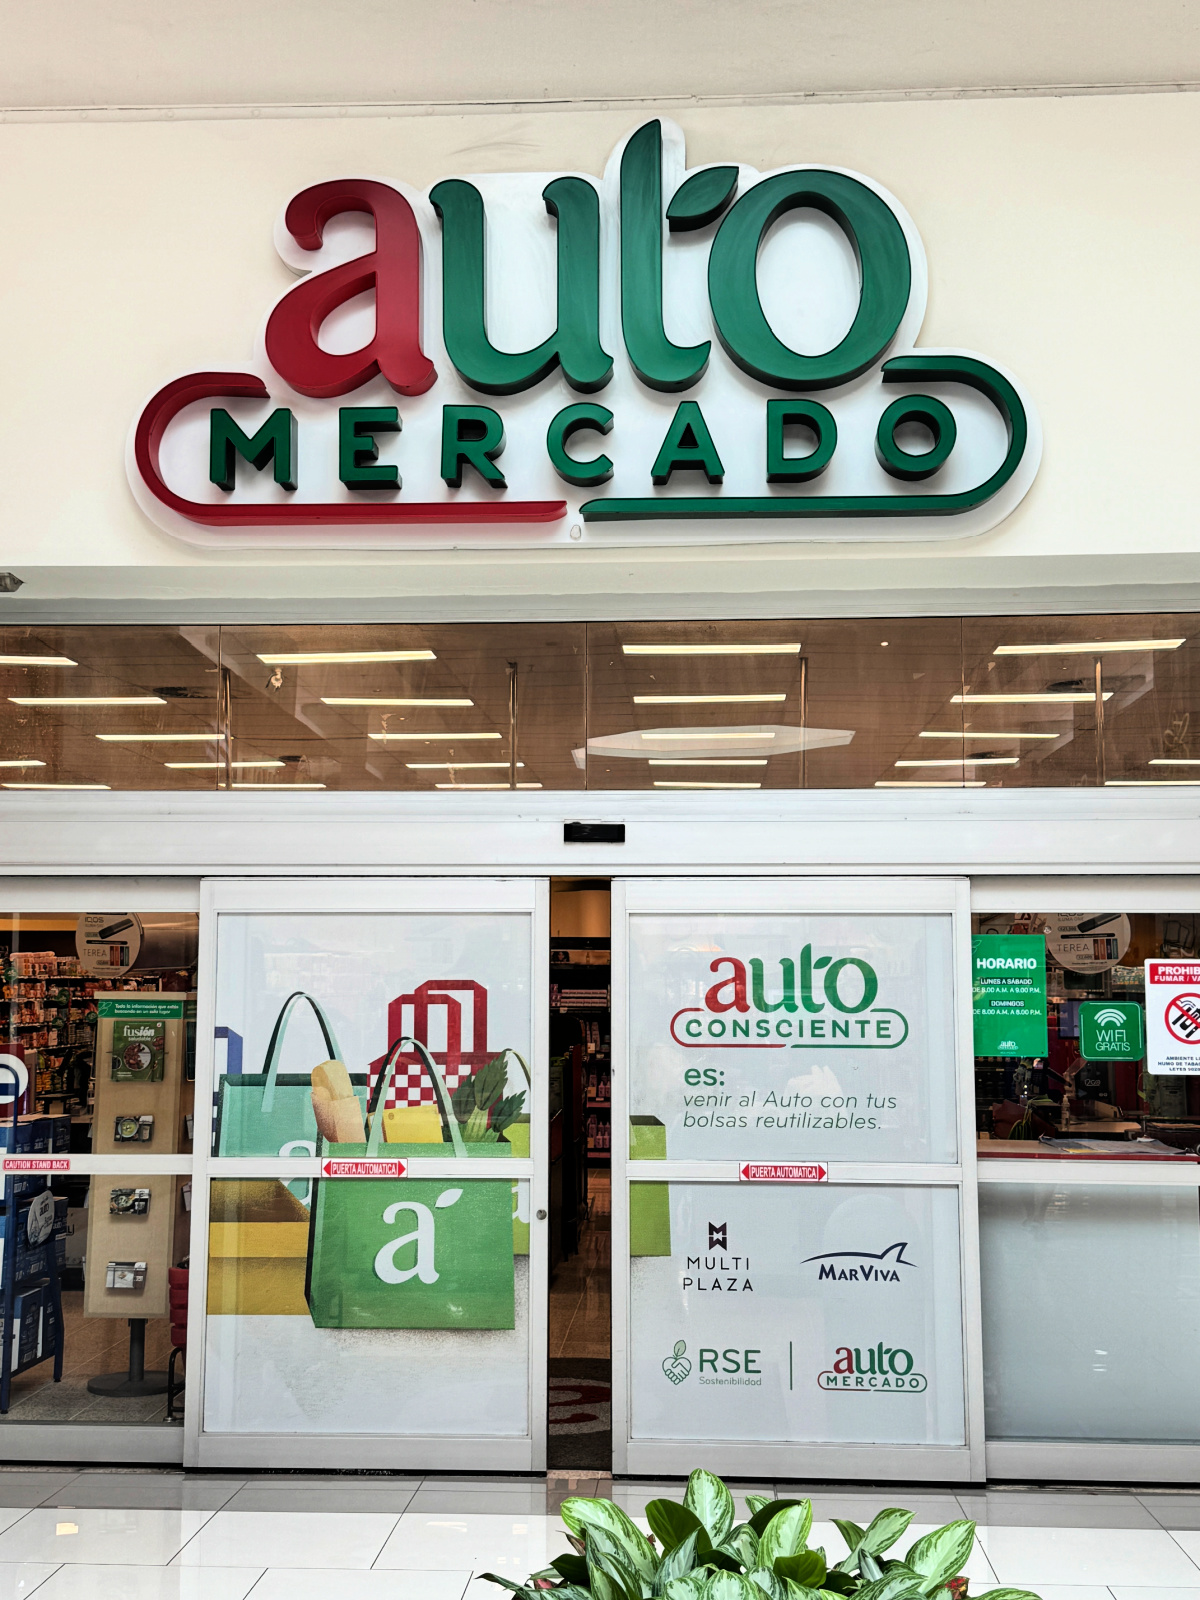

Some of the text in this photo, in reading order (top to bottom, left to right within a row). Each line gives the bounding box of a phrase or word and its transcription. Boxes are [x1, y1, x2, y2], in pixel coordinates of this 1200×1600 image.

[264, 118, 912, 397] auto
[210, 394, 957, 492] MERCADO
[83, 949, 107, 957] TEREA
[1057, 944, 1090, 952] TEREA
[976, 958, 1037, 969] HORARIO
[1158, 966, 1200, 975] PROHIB
[704, 943, 878, 1014] auto
[123, 1025, 155, 1036] fusión
[685, 1018, 891, 1039] CONSCIENTE
[1096, 1029, 1126, 1042] WIFI
[1095, 1042, 1130, 1051] GRATIS
[684, 1068, 725, 1086] es:
[683, 1091, 897, 1108] venir al Auto con tus
[683, 1111, 881, 1129] bolsas reutilizables.
[5, 1160, 67, 1169] CAUTION STAND BACK
[332, 1163, 396, 1174] PUERTA AUTOMATICA
[751, 1166, 816, 1178] PUERTA AUTOMATICA
[687, 1256, 749, 1270] MULTI
[683, 1278, 754, 1292] PLAZA
[700, 1348, 761, 1373] RSE
[833, 1341, 914, 1376] auto
[699, 1376, 762, 1386] Sostenibilidad
[826, 1376, 920, 1388] MERCADO
